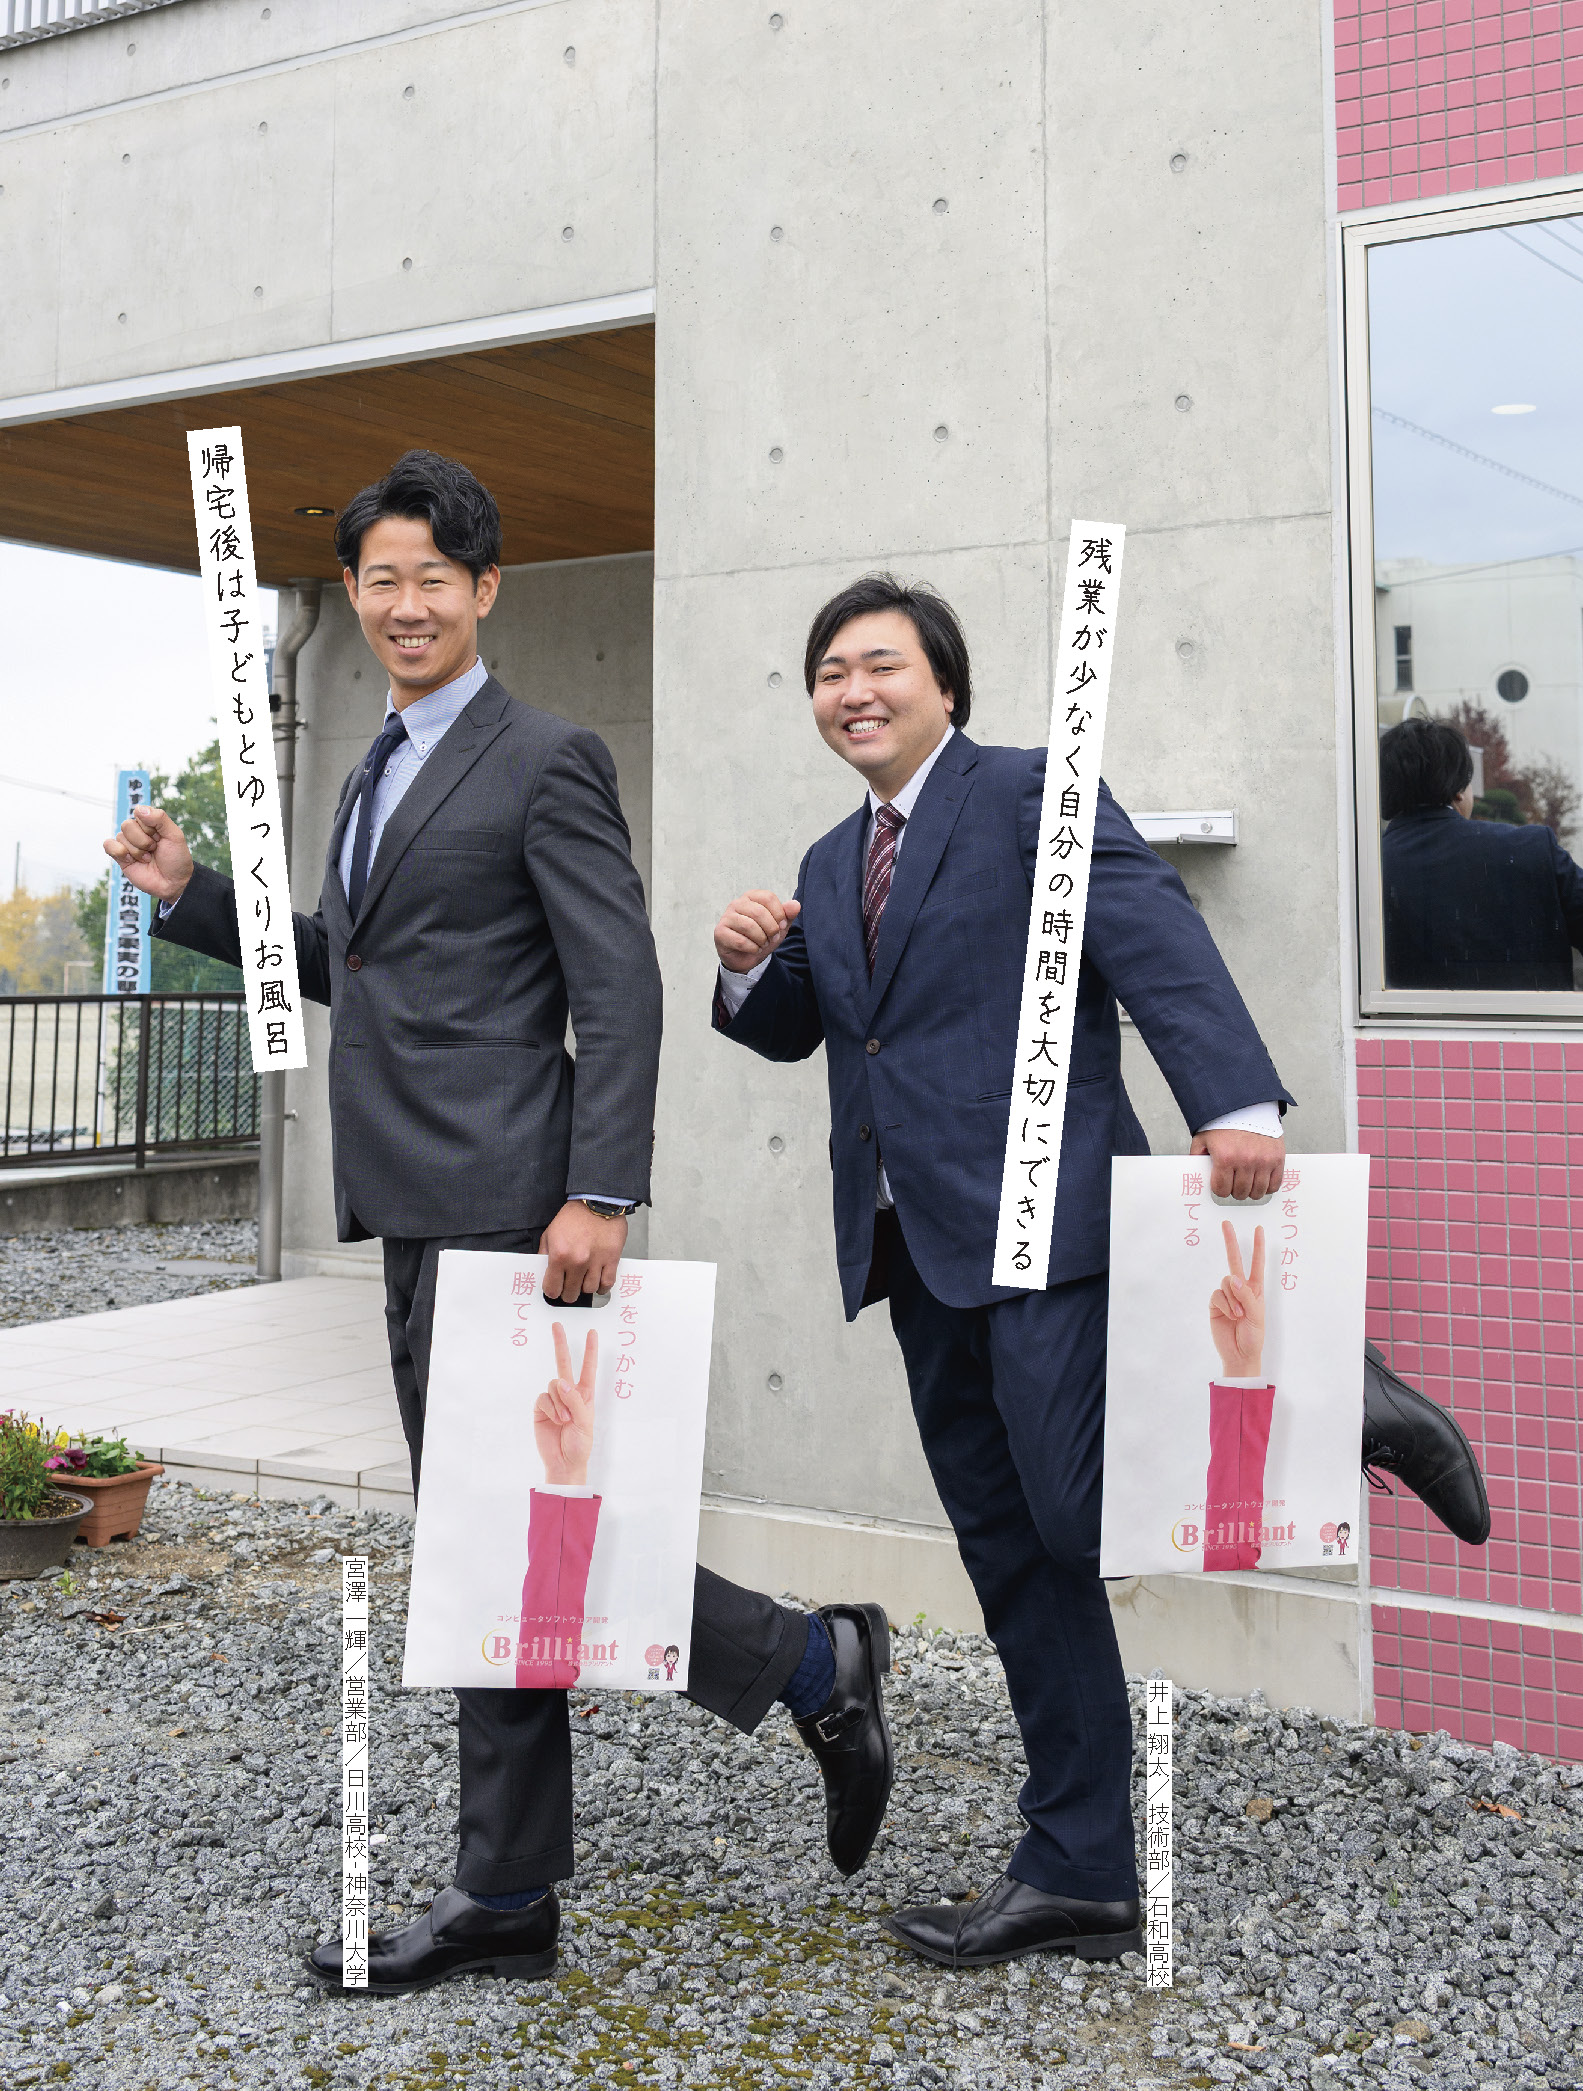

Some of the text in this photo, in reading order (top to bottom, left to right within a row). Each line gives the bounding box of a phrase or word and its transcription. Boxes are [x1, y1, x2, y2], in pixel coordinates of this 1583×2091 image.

[1181, 1172, 1205, 1247] 勝てる
[1281, 1169, 1301, 1291] 夢をつかむ
[510, 1271, 537, 1347] 勝てる
[614, 1273, 643, 1399] 夢をつかむ
[1184, 1499, 1286, 1511] コンピュータソフトウェア開発
[1180, 1520, 1297, 1546] Brilliant
[496, 1614, 609, 1624] コンピュータソフトウェア開発
[491, 1635, 619, 1661] Brilliant
